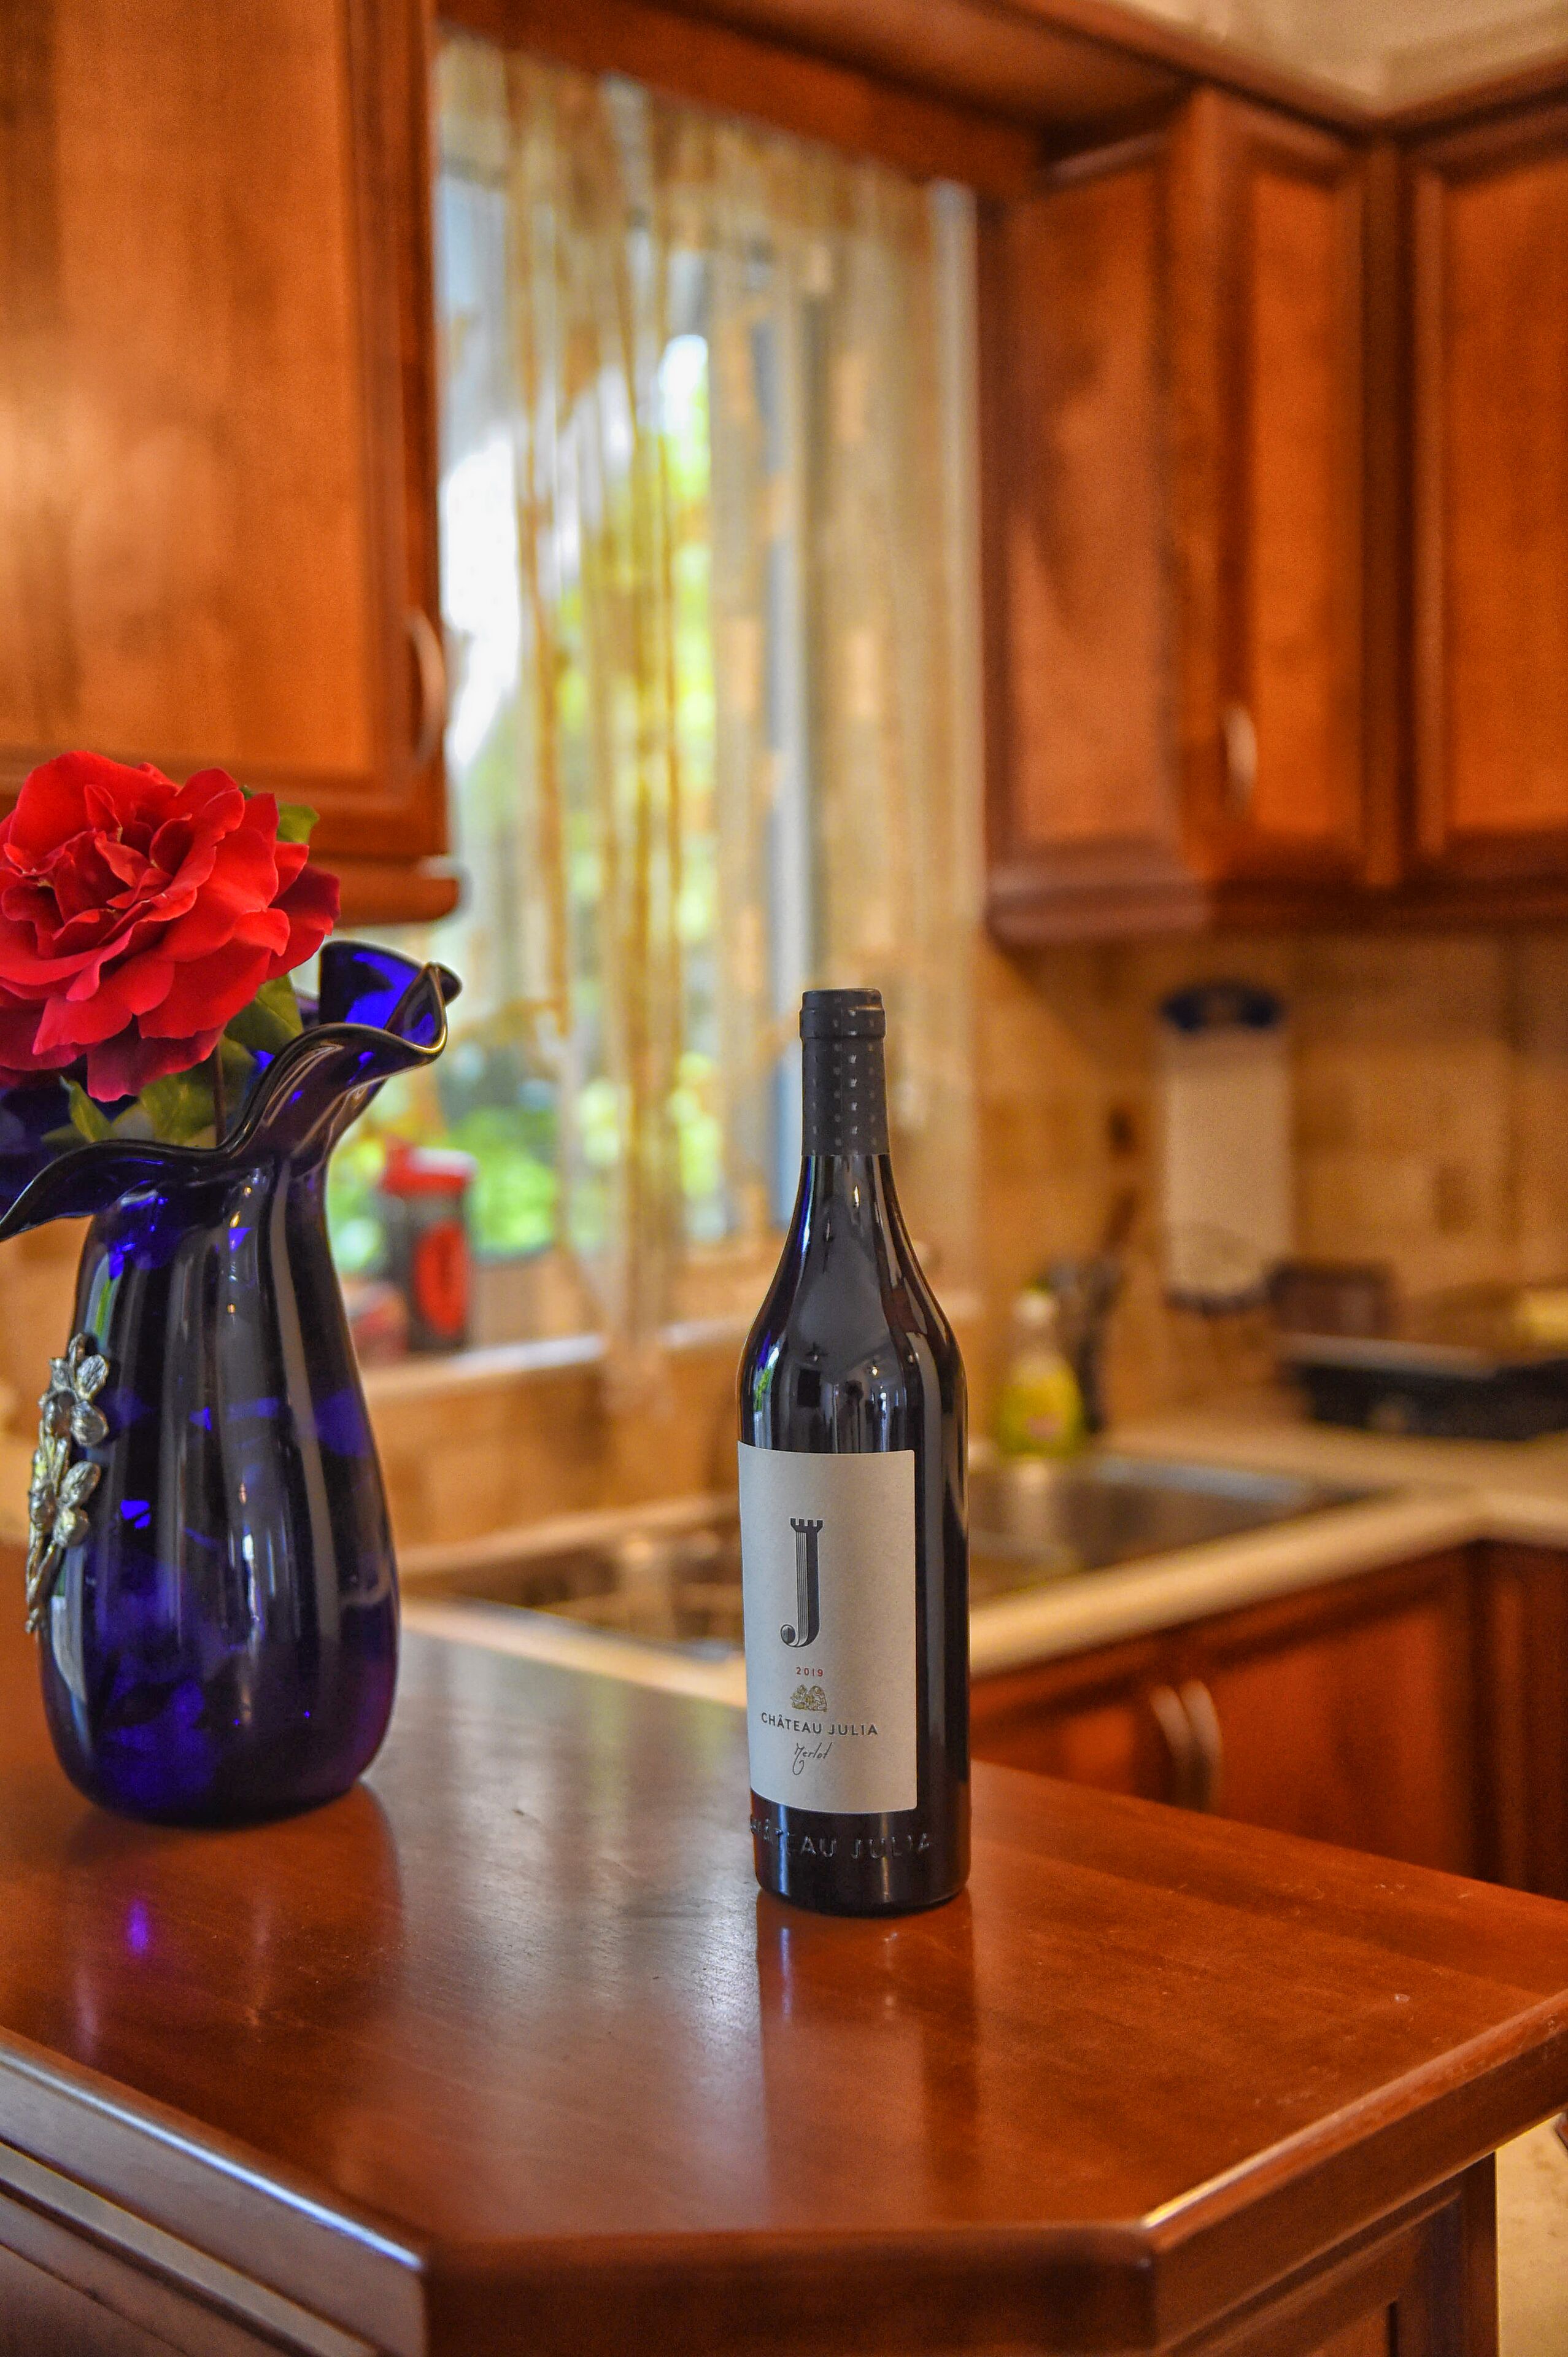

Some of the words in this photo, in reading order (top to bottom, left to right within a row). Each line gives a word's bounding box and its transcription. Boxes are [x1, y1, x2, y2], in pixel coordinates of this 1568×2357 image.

[780, 1517, 824, 1647] J
[795, 1666, 824, 1678] 2019
[761, 1712, 822, 1735] CHÂTEAU
[828, 1724, 878, 1736] JULIA
[792, 1742, 833, 1776] Merlot
